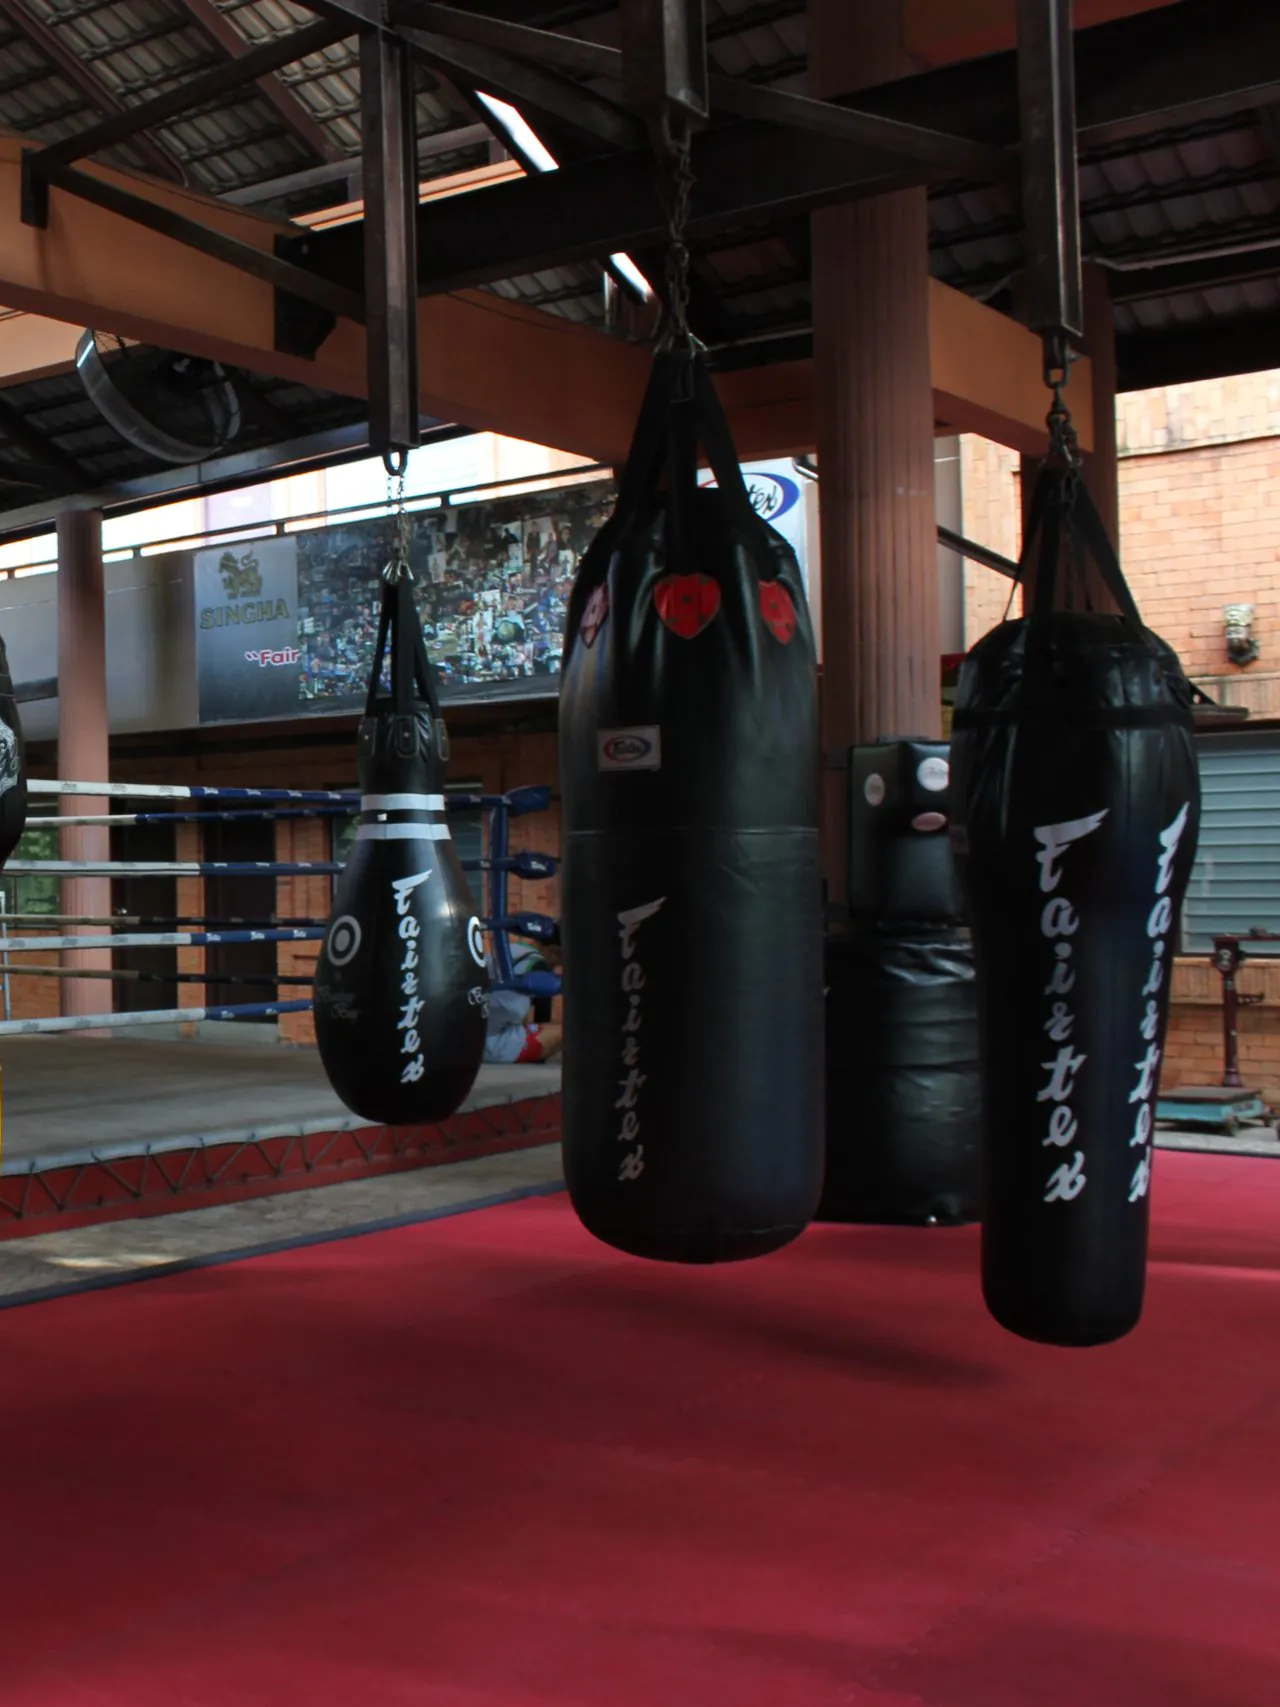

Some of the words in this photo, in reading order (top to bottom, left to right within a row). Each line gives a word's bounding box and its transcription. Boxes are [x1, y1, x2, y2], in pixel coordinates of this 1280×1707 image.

[199, 598, 290, 630] SINGHA
[391, 869, 433, 1084] Fairtex
[615, 896, 667, 1181] Fairtex
[1033, 807, 1111, 1203] Fairtex
[1128, 801, 1190, 1203] Fairtex
